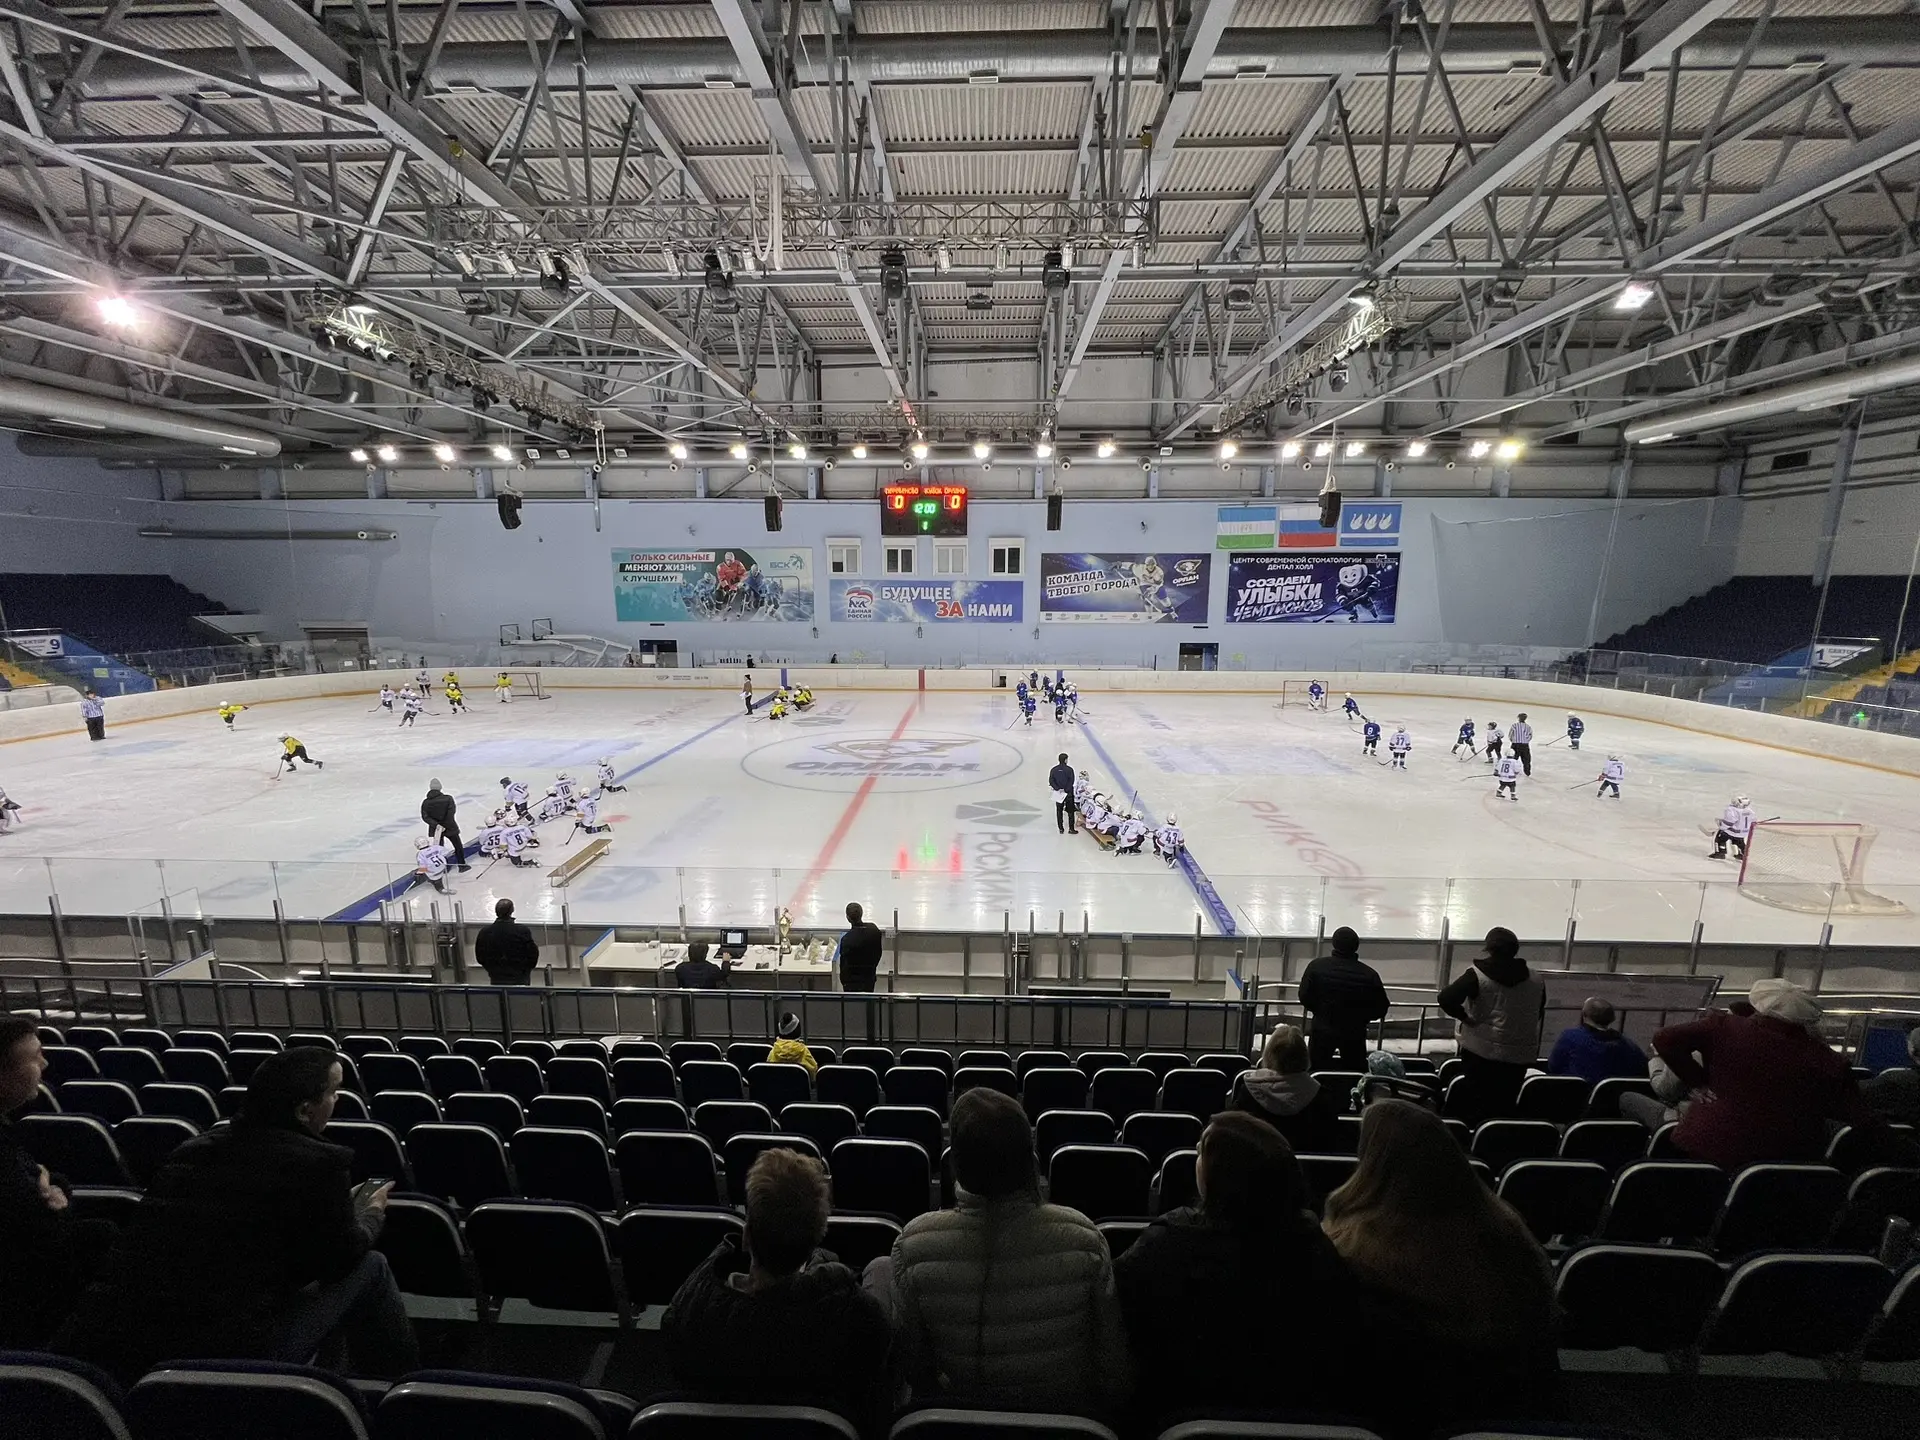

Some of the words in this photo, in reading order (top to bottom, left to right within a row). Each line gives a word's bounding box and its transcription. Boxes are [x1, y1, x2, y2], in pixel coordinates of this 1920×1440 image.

[894, 495, 904, 509] 0
[951, 495, 961, 509] 0
[1256, 556, 1306, 564] СОВРЕМЕННОЙ
[1048, 570, 1104, 585] КОМАНДА
[1172, 574, 1199, 584] ОРЛАН
[1246, 575, 1312, 588] СОЗДАЕМ
[881, 586, 951, 602] БУДУЩЕЕ
[1048, 584, 1090, 597] ТВОЕГО
[1094, 578, 1138, 591] ГОРОДА
[1236, 583, 1323, 606] УЛЫБКИ
[935, 601, 964, 618] ЗА
[968, 604, 1013, 616] НАМИ
[1233, 598, 1324, 622] ЧЕМПИОНОВ
[49, 639, 60, 650] 9
[1816, 648, 1824, 660] 1
[1368, 727, 1374, 735] 8
[786, 761, 980, 772] ОРЛАН
[1500, 763, 1510, 774] 18
[561, 785, 570, 795] 10
[487, 834, 500, 845] 55
[515, 834, 524, 846] 8
[1165, 832, 1178, 845] 43
[430, 855, 444, 868] 51
